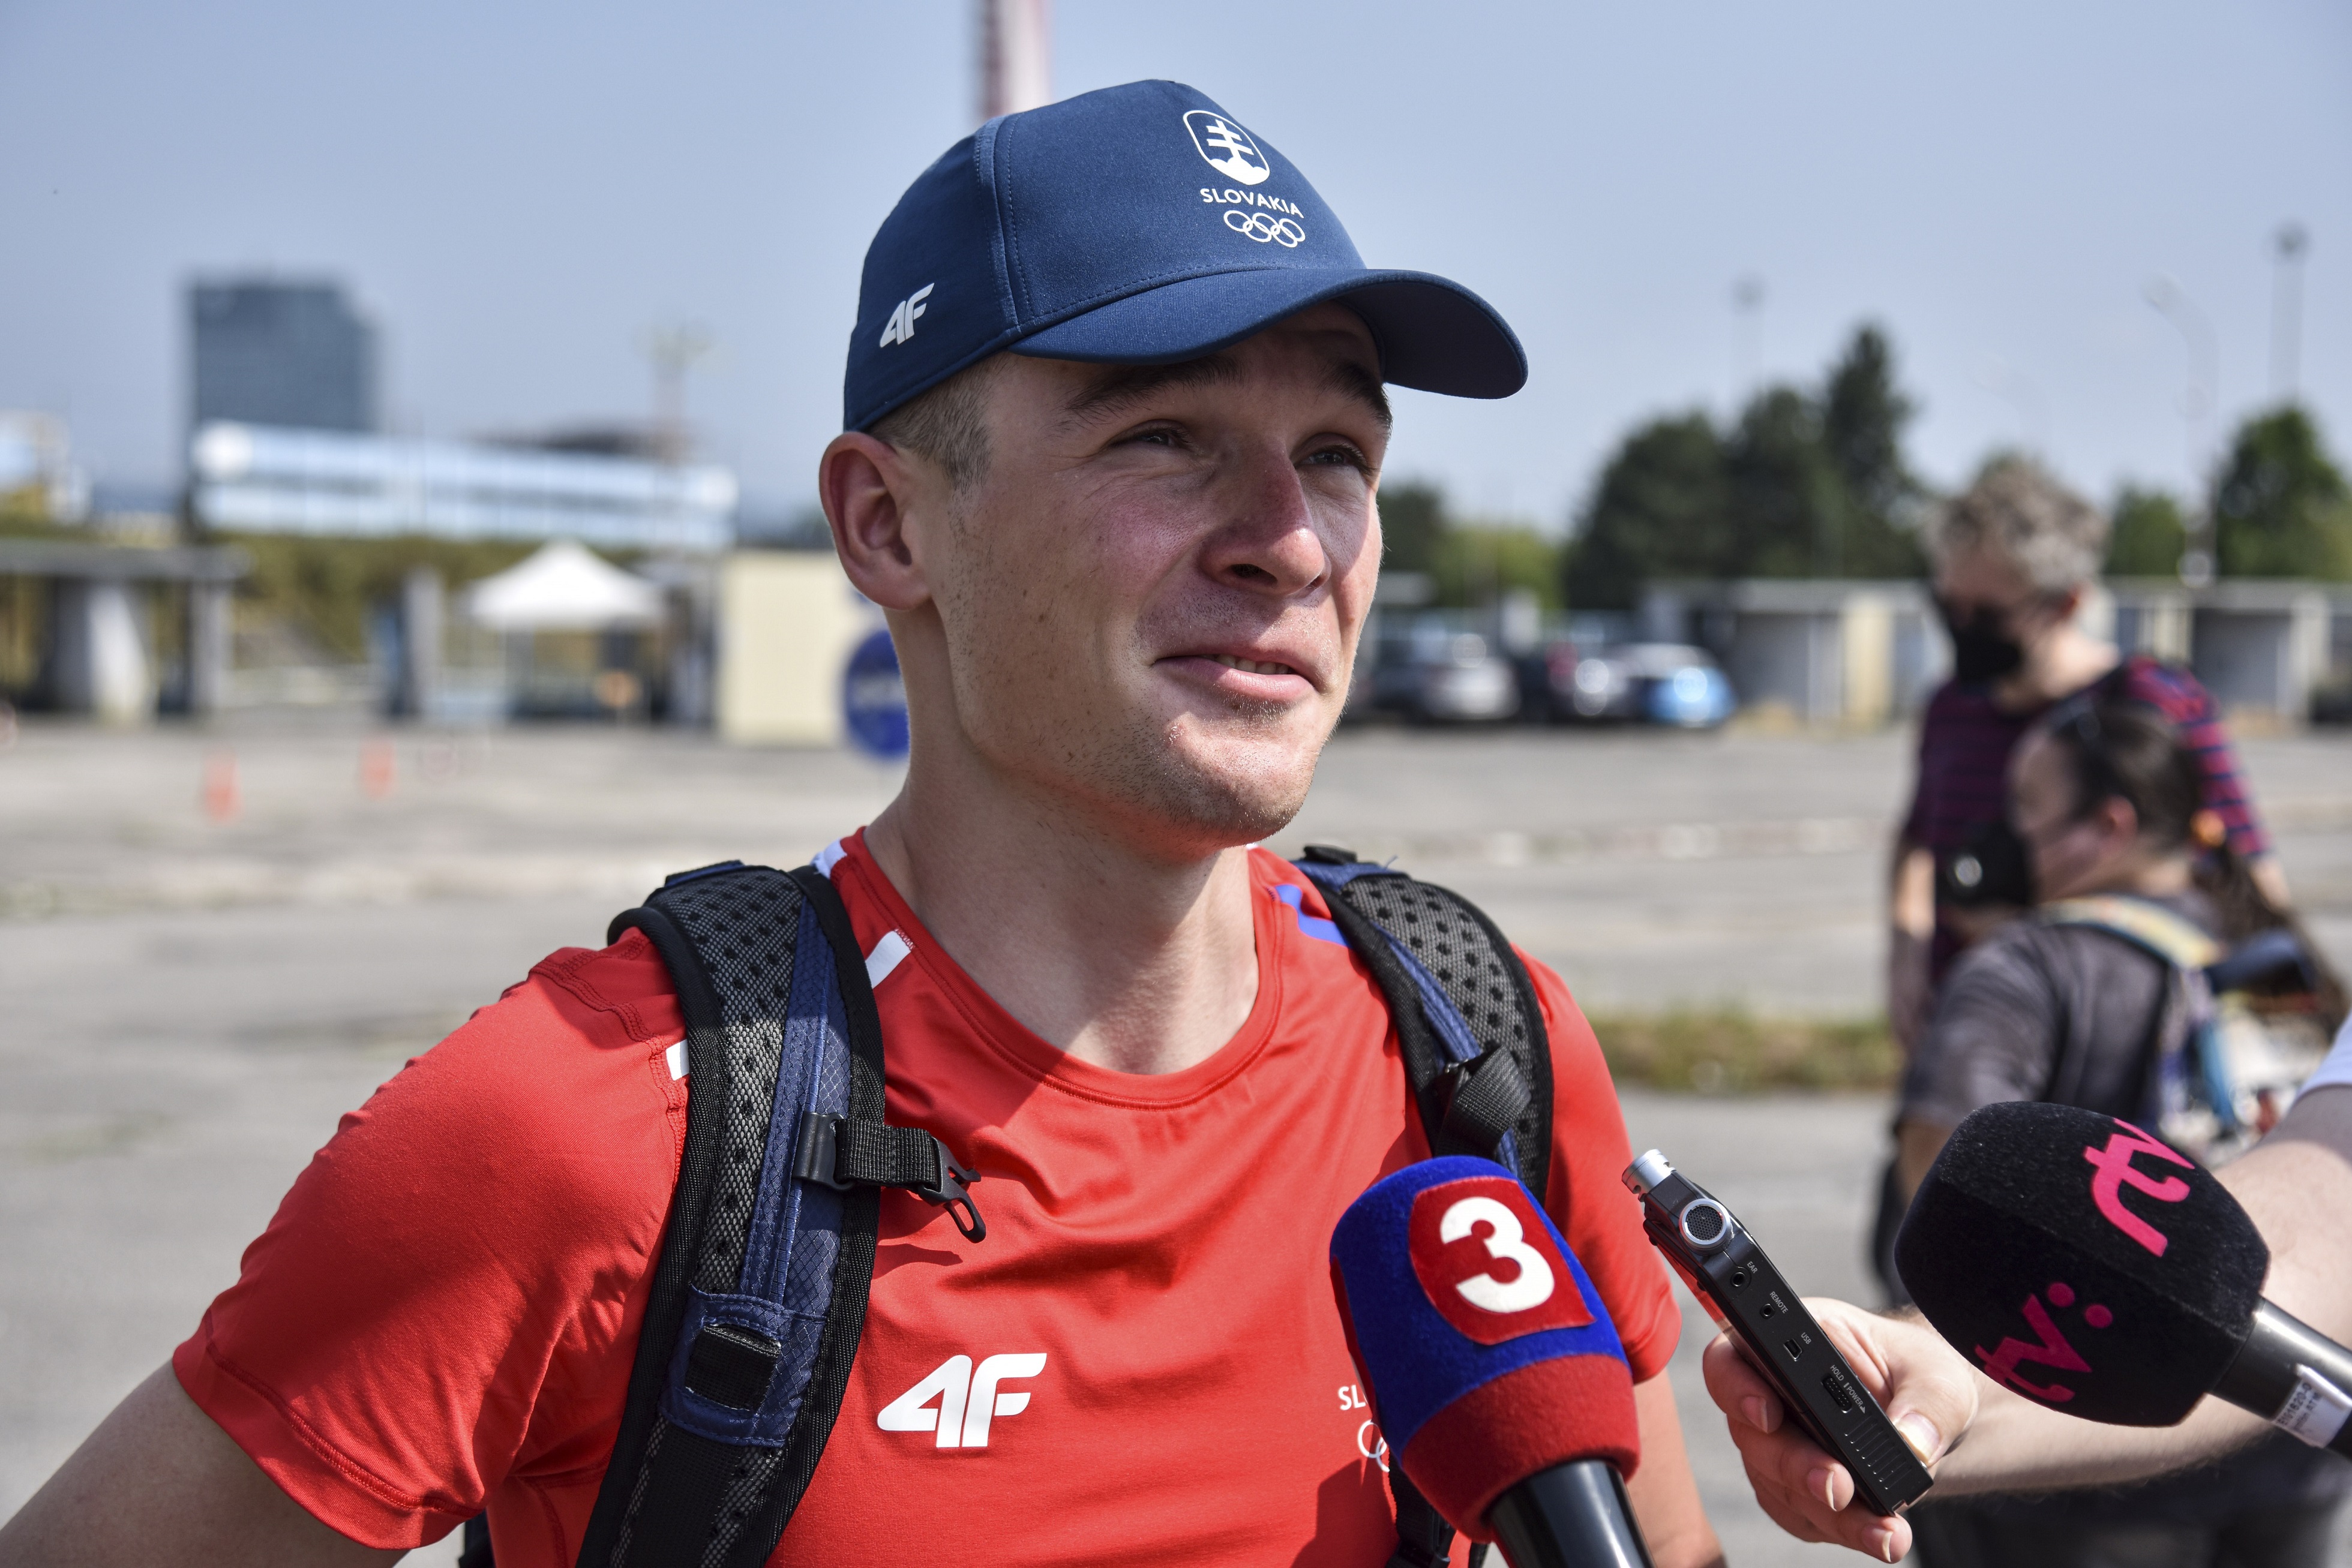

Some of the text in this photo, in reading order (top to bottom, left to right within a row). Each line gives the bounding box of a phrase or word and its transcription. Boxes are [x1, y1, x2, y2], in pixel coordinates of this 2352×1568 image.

[1200, 188, 1304, 219] SLOVAKIA
[880, 282, 935, 348] 4F
[1440, 1196, 1555, 1314] 3
[1747, 1260, 1759, 1274] EAR
[1769, 1290, 1789, 1314] REMOTE
[1801, 1332, 1812, 1344] USB
[1974, 1281, 2113, 1407] tv:
[877, 1353, 1047, 1448] 4F
[1337, 1385, 1368, 1411] SL
[1830, 1364, 1864, 1407] HOLD POWER
